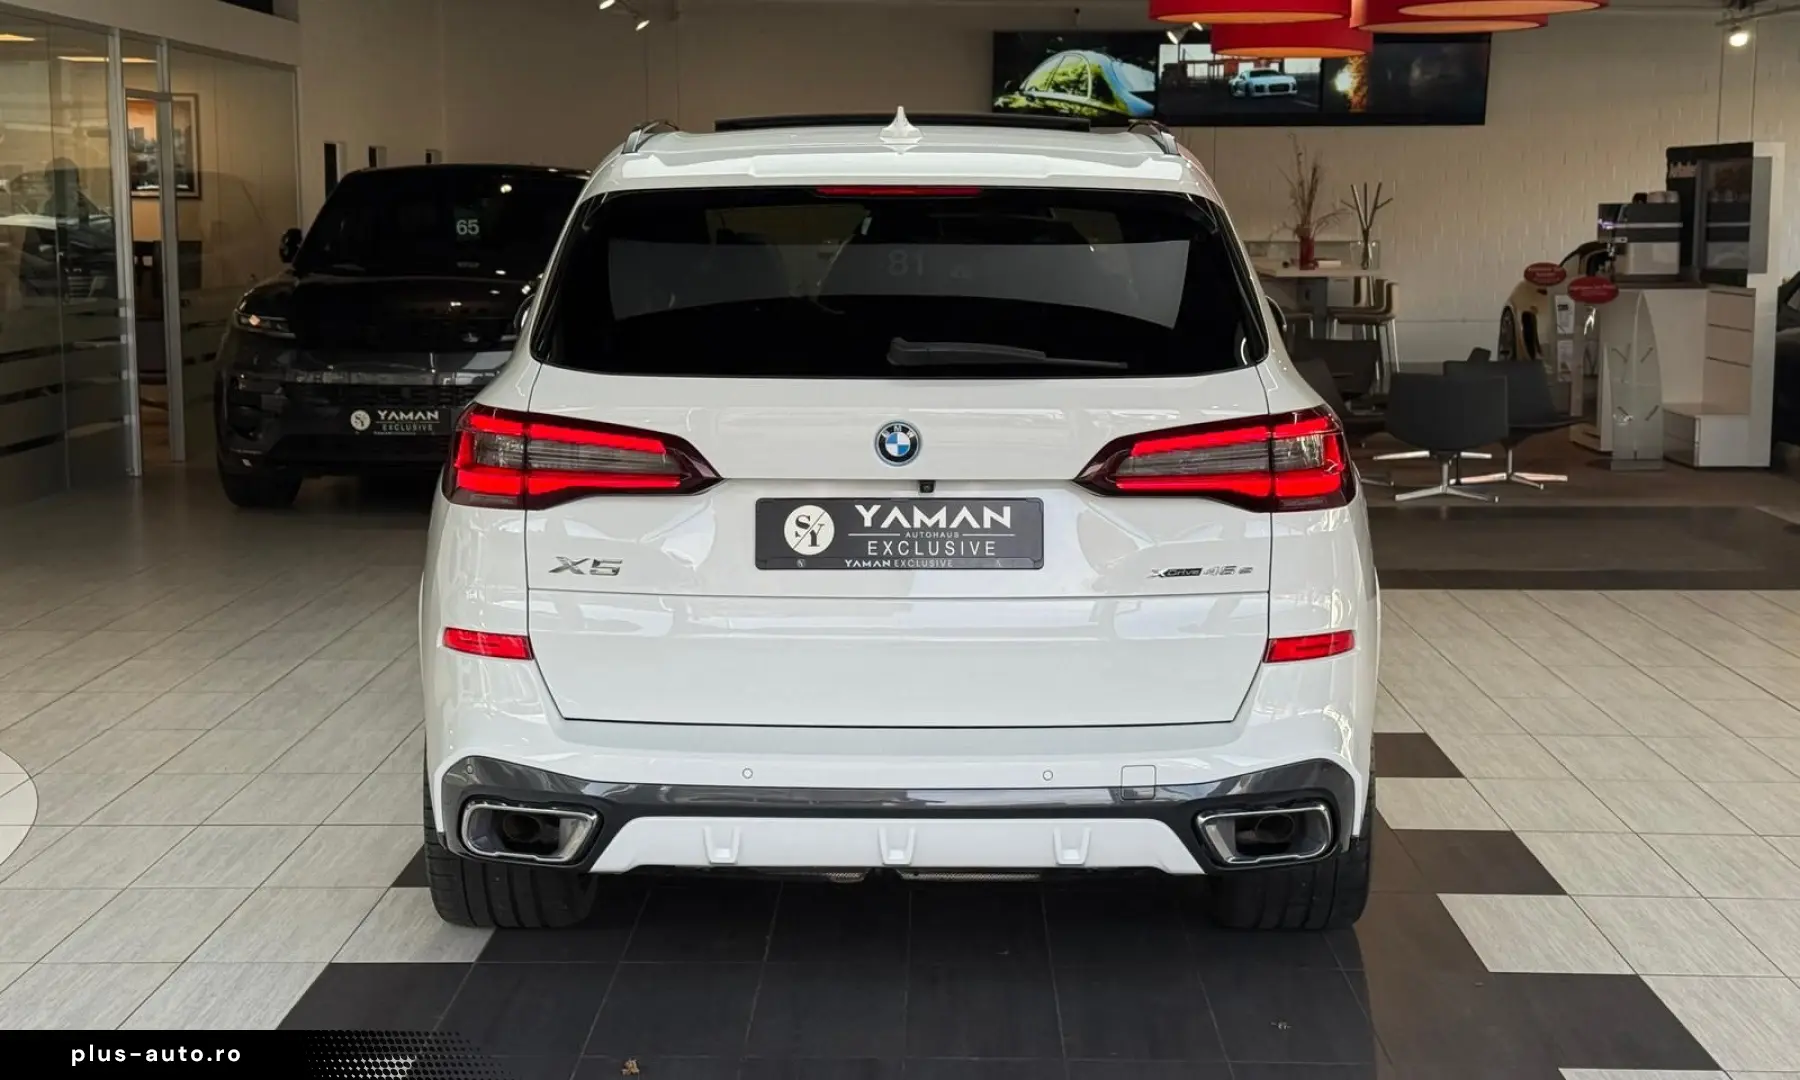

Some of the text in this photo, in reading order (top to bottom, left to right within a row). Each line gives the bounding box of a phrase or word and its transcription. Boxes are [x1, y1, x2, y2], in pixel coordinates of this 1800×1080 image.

[456, 219, 480, 235] 65
[377, 410, 439, 421] YAMAN
[854, 504, 1012, 529] YAMAN
[904, 531, 960, 539] AUTOHAUS
[867, 540, 996, 556] EXCLUSIVE
[548, 556, 623, 576] X5
[844, 559, 953, 568] YAMAN EXCLUSIVE
